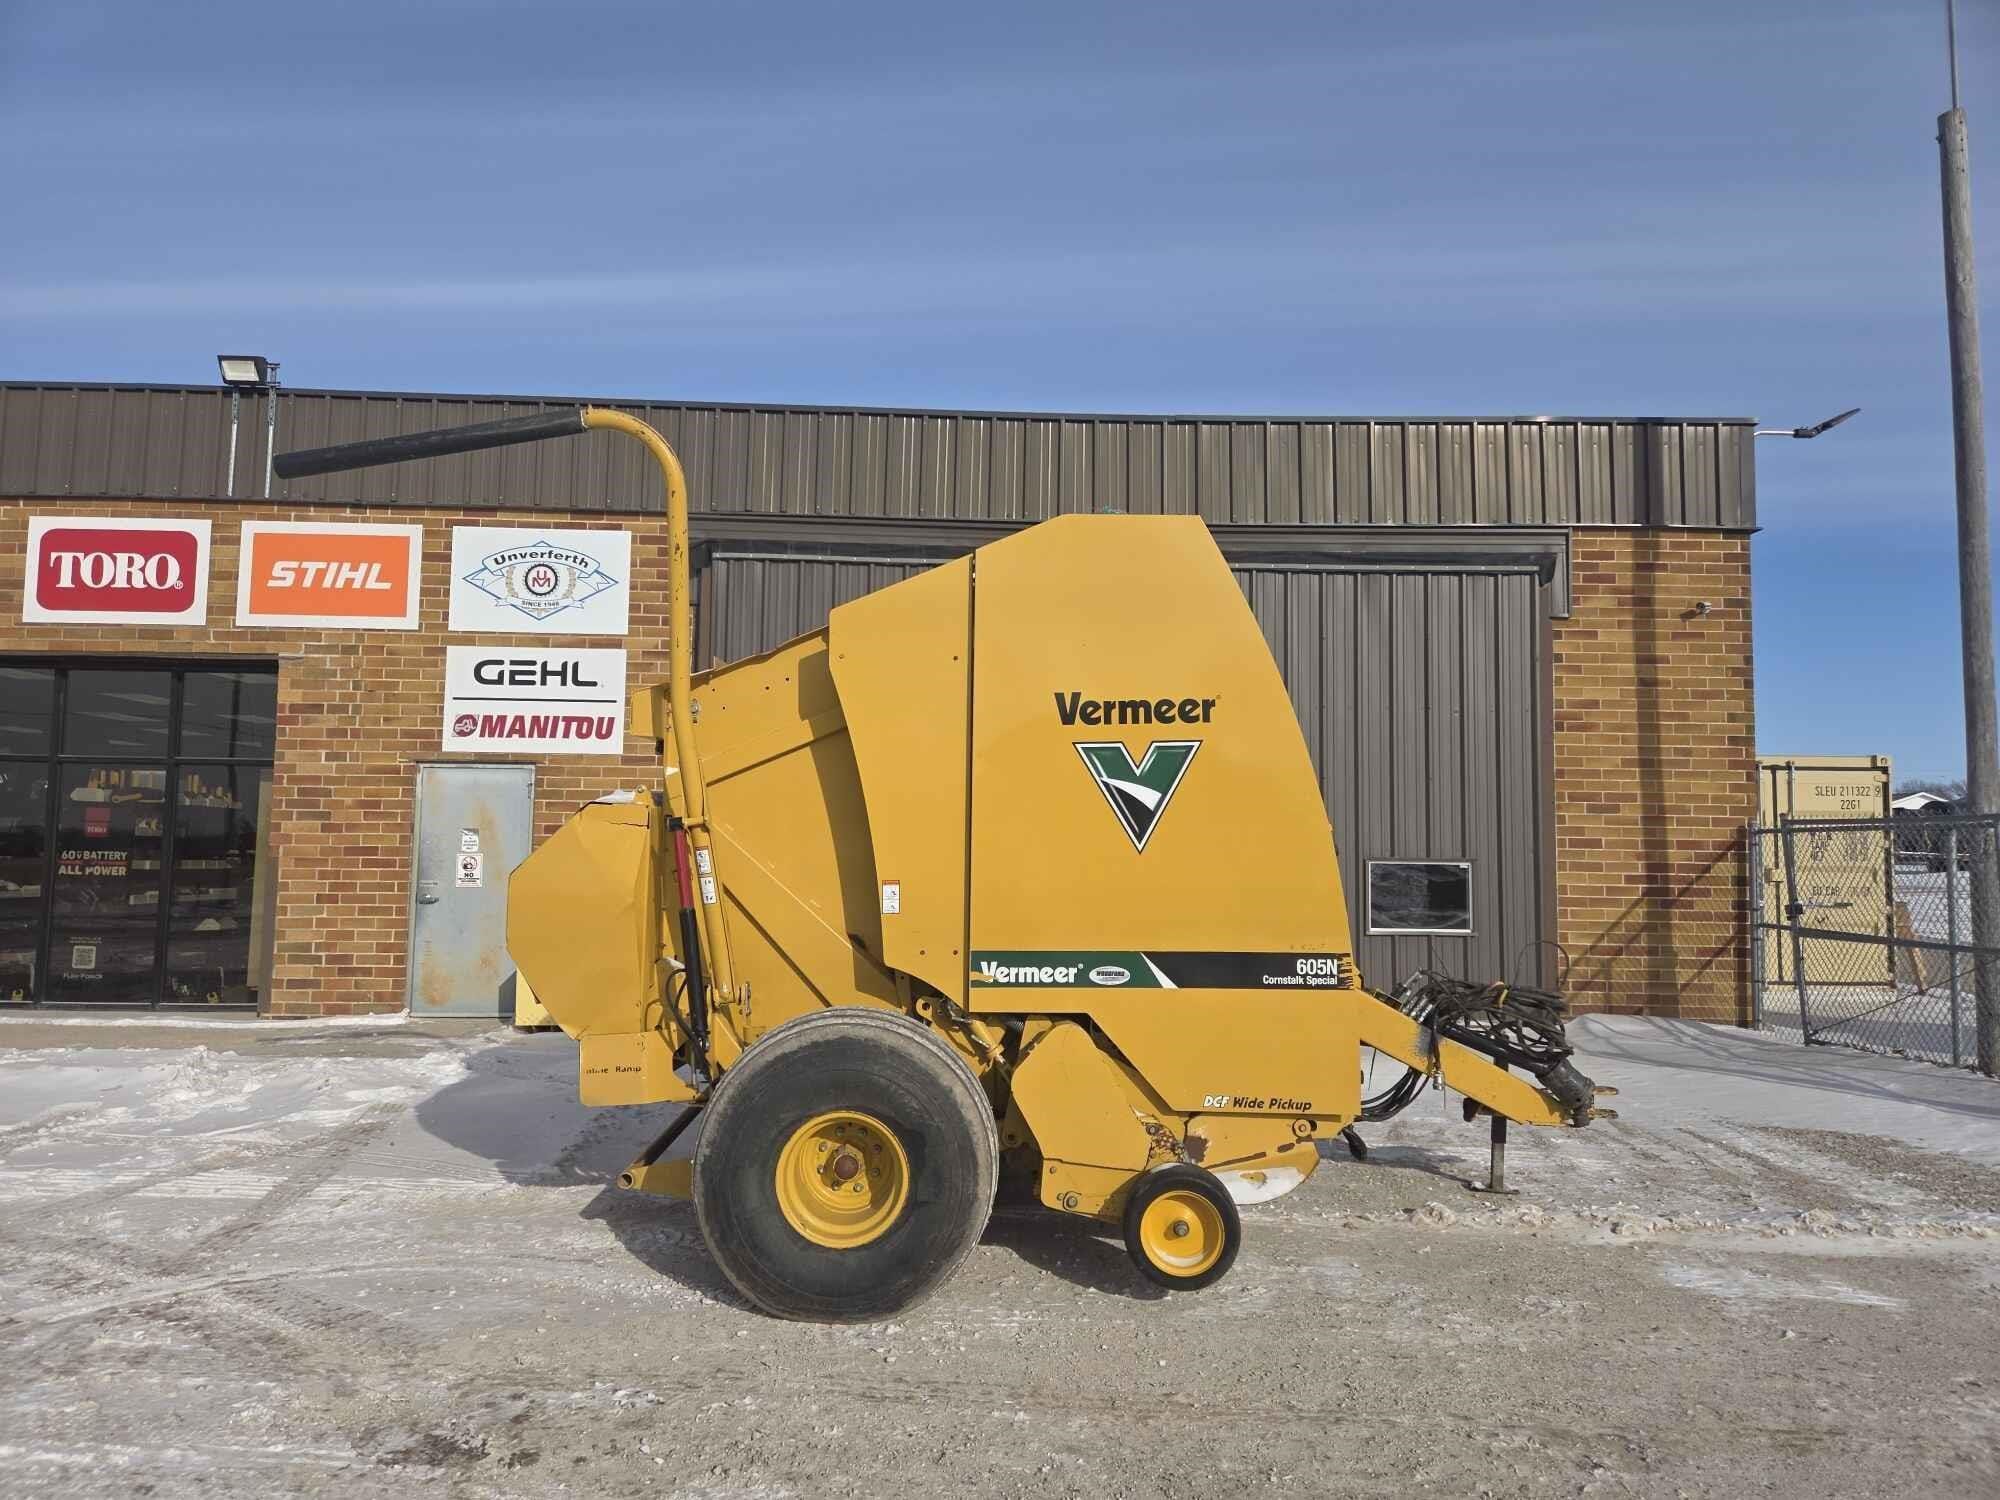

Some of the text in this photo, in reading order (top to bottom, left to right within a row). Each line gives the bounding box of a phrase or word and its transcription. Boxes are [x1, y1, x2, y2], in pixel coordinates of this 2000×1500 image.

[493, 549, 590, 569] Unverferth
[50, 552, 180, 590] TORO
[266, 561, 393, 589] STIHL
[521, 600, 542, 608] SINCE
[473, 659, 598, 687] GEHL
[1054, 692, 1216, 726] Vermeer
[479, 714, 616, 740] MANITOU
[1815, 786, 1881, 797] SLEU 211322 9
[1840, 799, 1860, 810] 22G1
[83, 850, 128, 860] BATTERY
[58, 865, 127, 876] ALL POWER
[978, 961, 1079, 984] Vermeer
[1296, 959, 1338, 975] 605N
[1262, 975, 1338, 986] Cornstalk Special
[1203, 1095, 1312, 1112] DCF Wide Pickup
